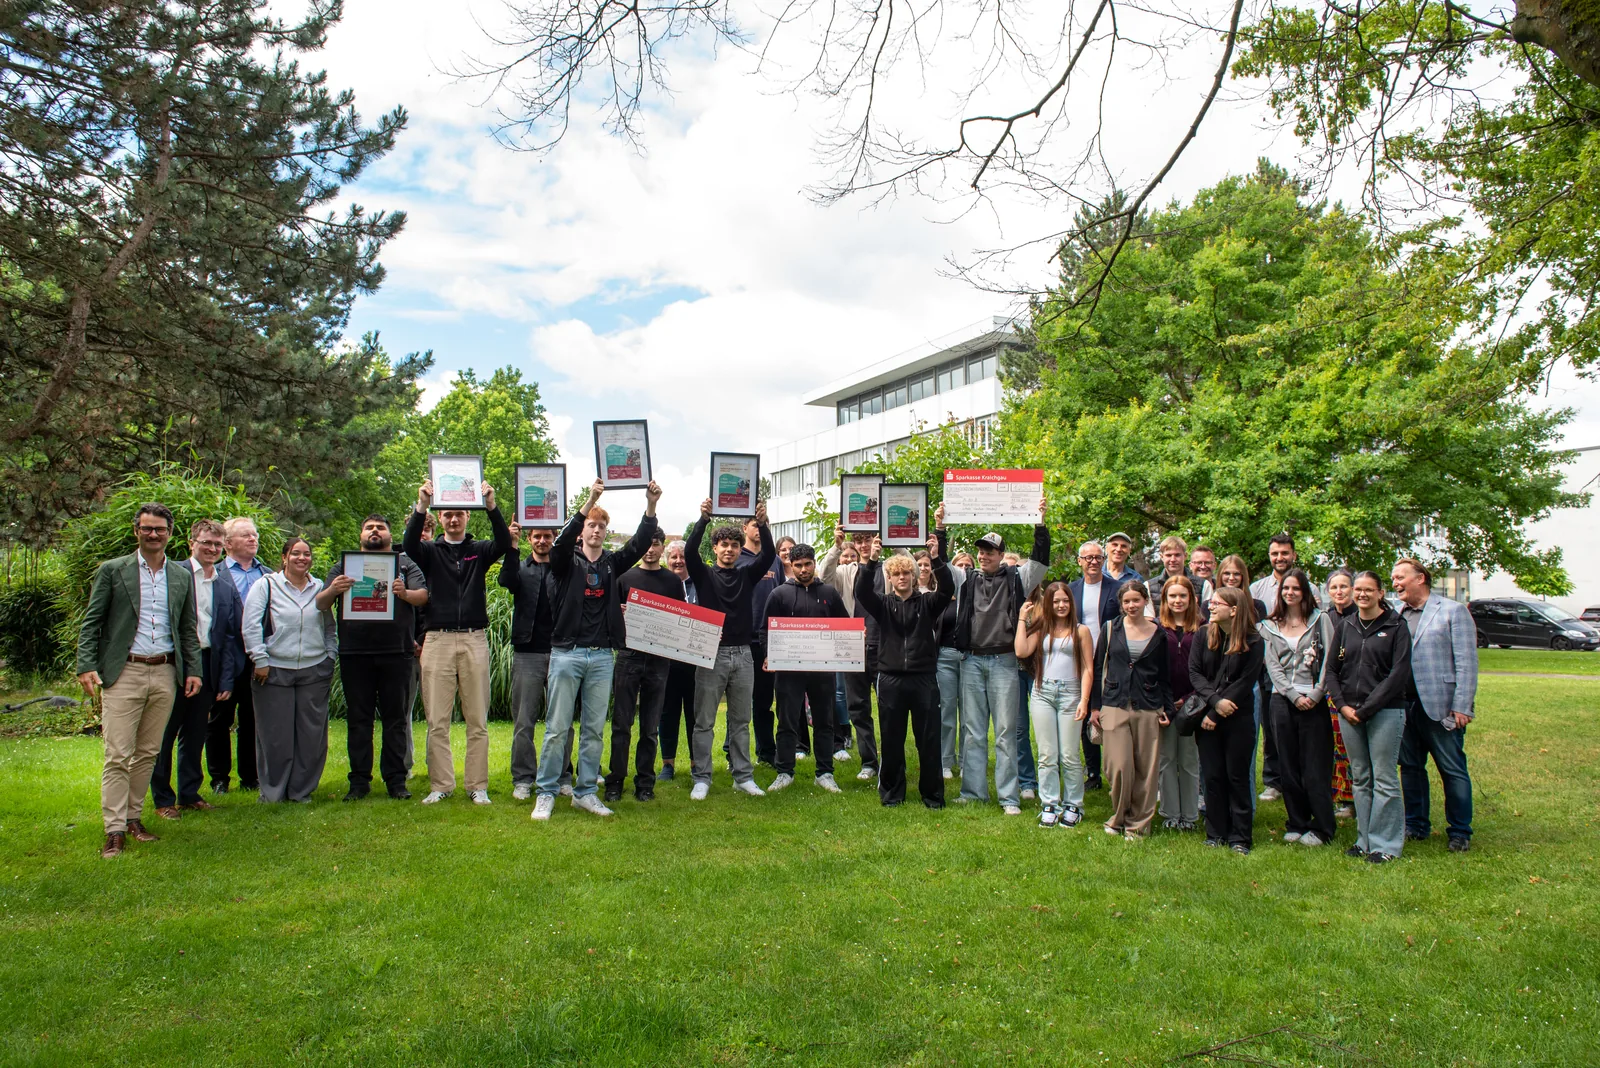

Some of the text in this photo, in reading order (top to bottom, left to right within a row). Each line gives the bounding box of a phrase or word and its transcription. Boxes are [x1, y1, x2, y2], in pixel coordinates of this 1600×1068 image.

[640, 597, 691, 615] Sparkasse Kraichgau
[805, 622, 830, 630] Kraichgau
